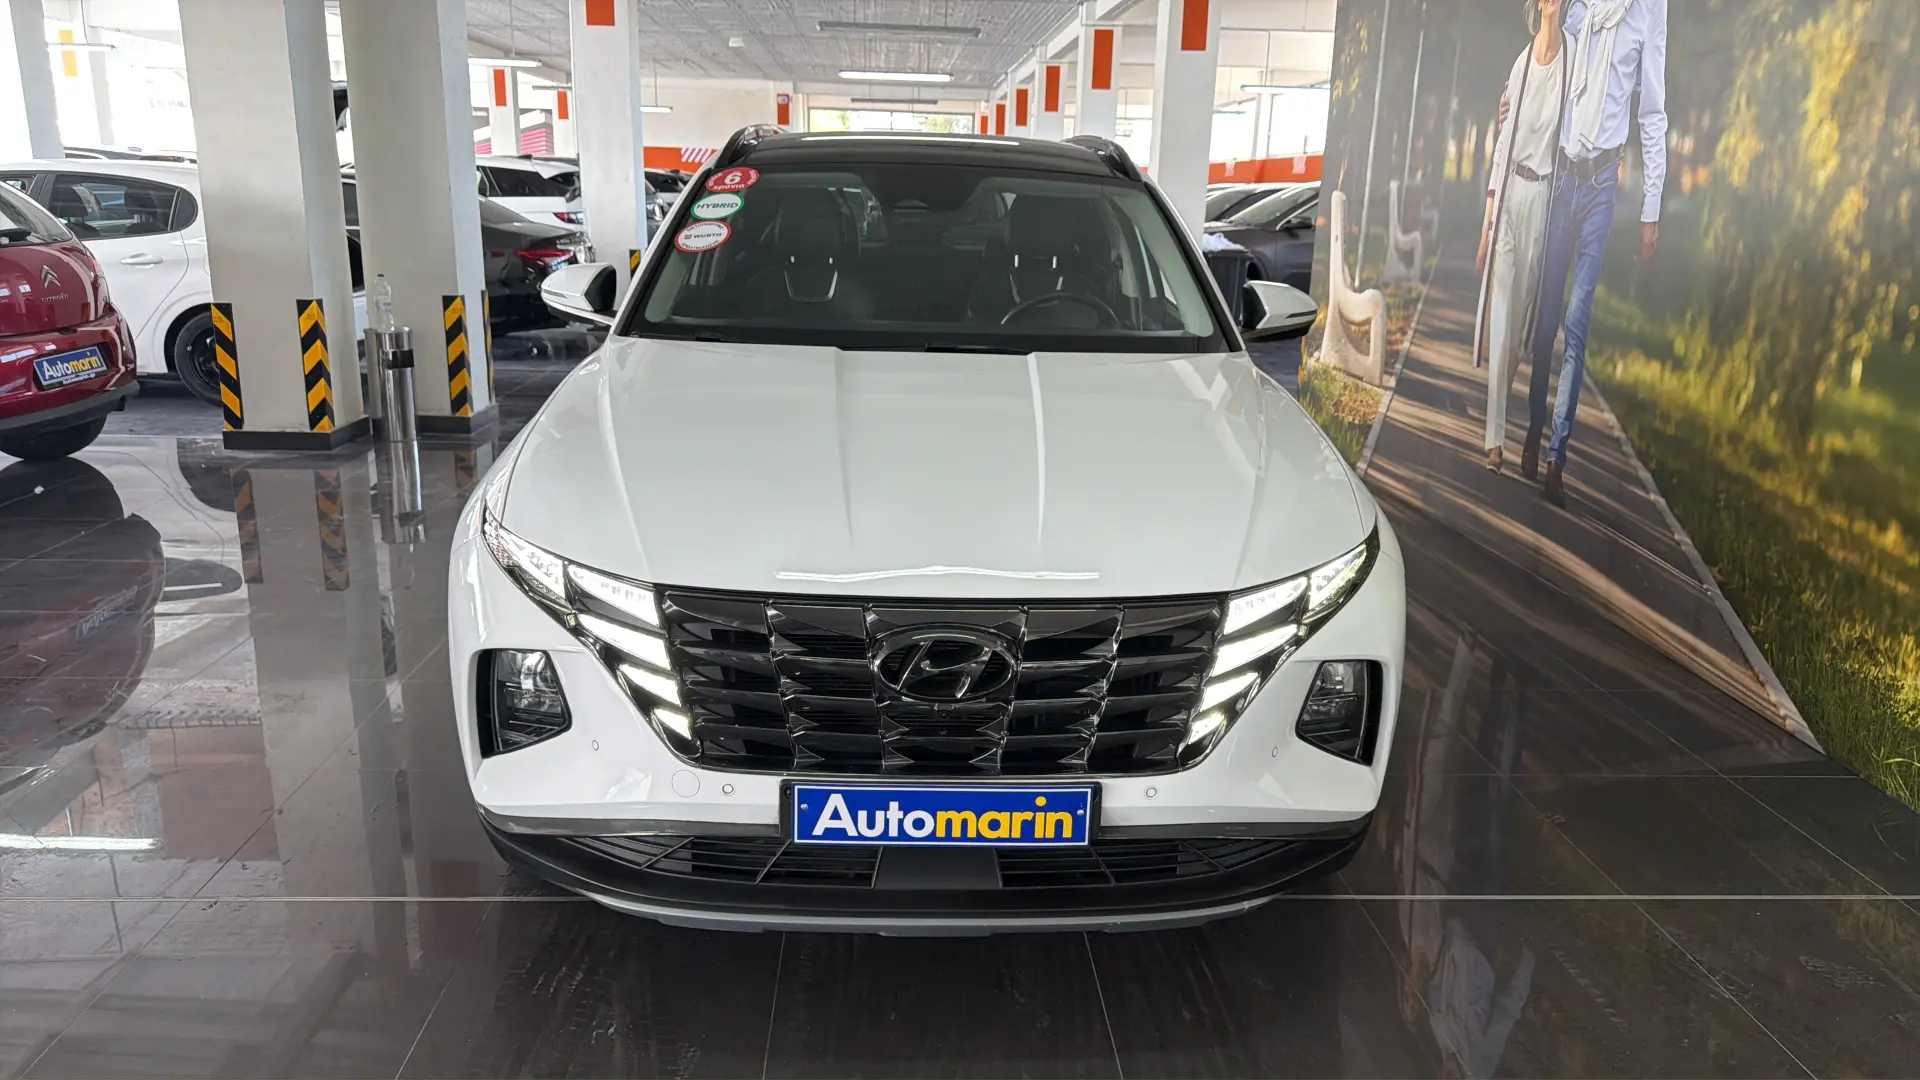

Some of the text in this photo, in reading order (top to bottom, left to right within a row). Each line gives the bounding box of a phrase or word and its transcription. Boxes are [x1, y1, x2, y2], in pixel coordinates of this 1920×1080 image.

[725, 171, 743, 185] 6
[42, 351, 101, 380] Automarin
[812, 793, 1073, 839] Automarin
